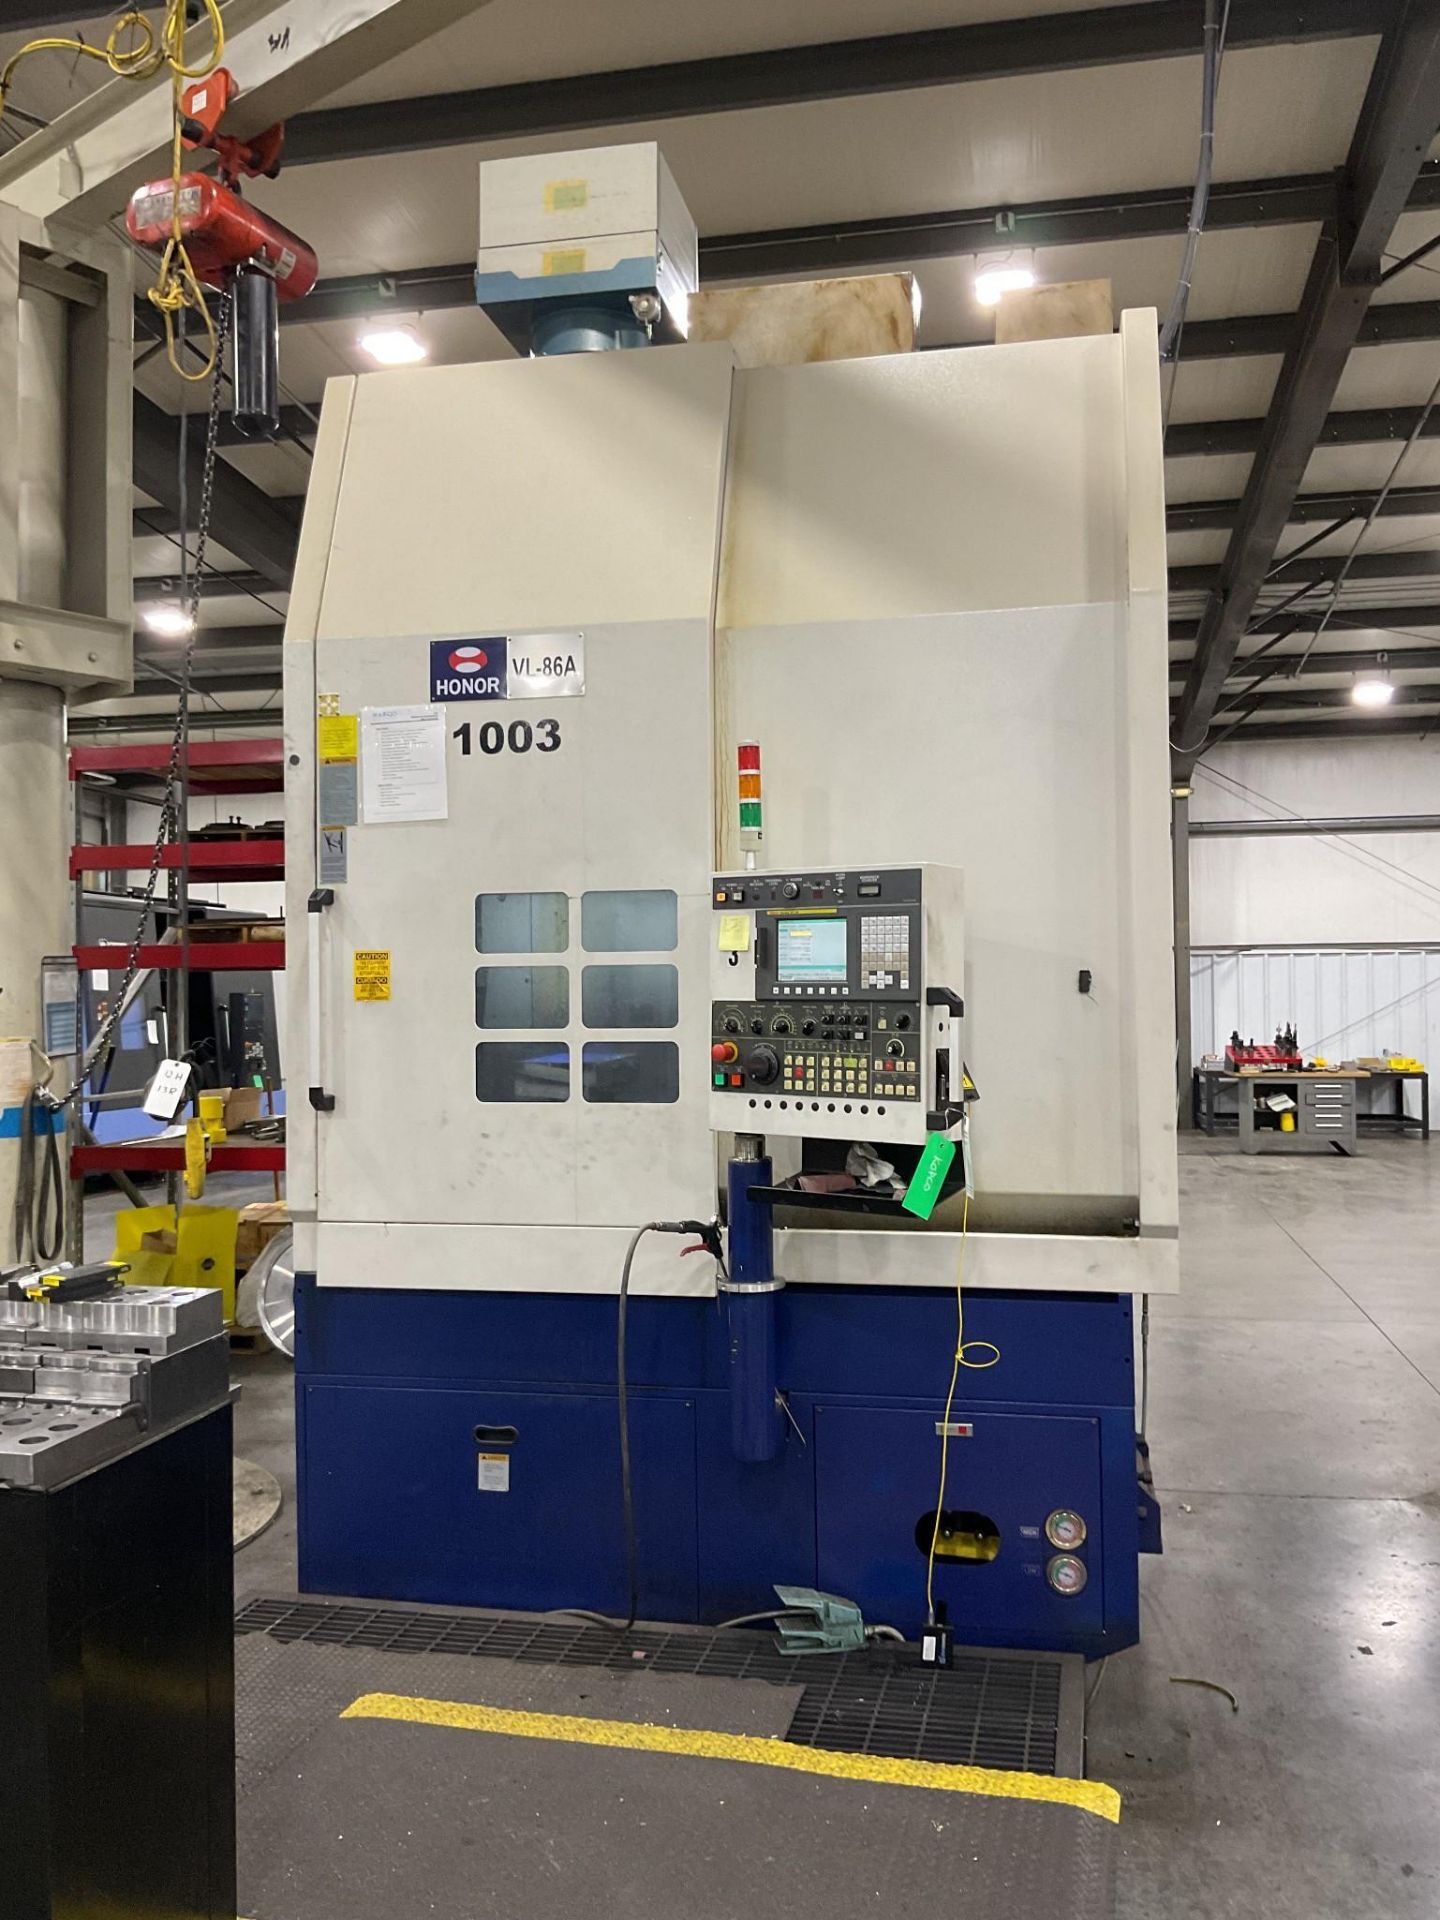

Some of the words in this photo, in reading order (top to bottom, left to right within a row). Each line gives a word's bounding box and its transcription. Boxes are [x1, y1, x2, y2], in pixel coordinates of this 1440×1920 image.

[512, 655, 577, 677] VL-86A
[436, 677, 500, 695] HONOR
[453, 719, 561, 755] 1003
